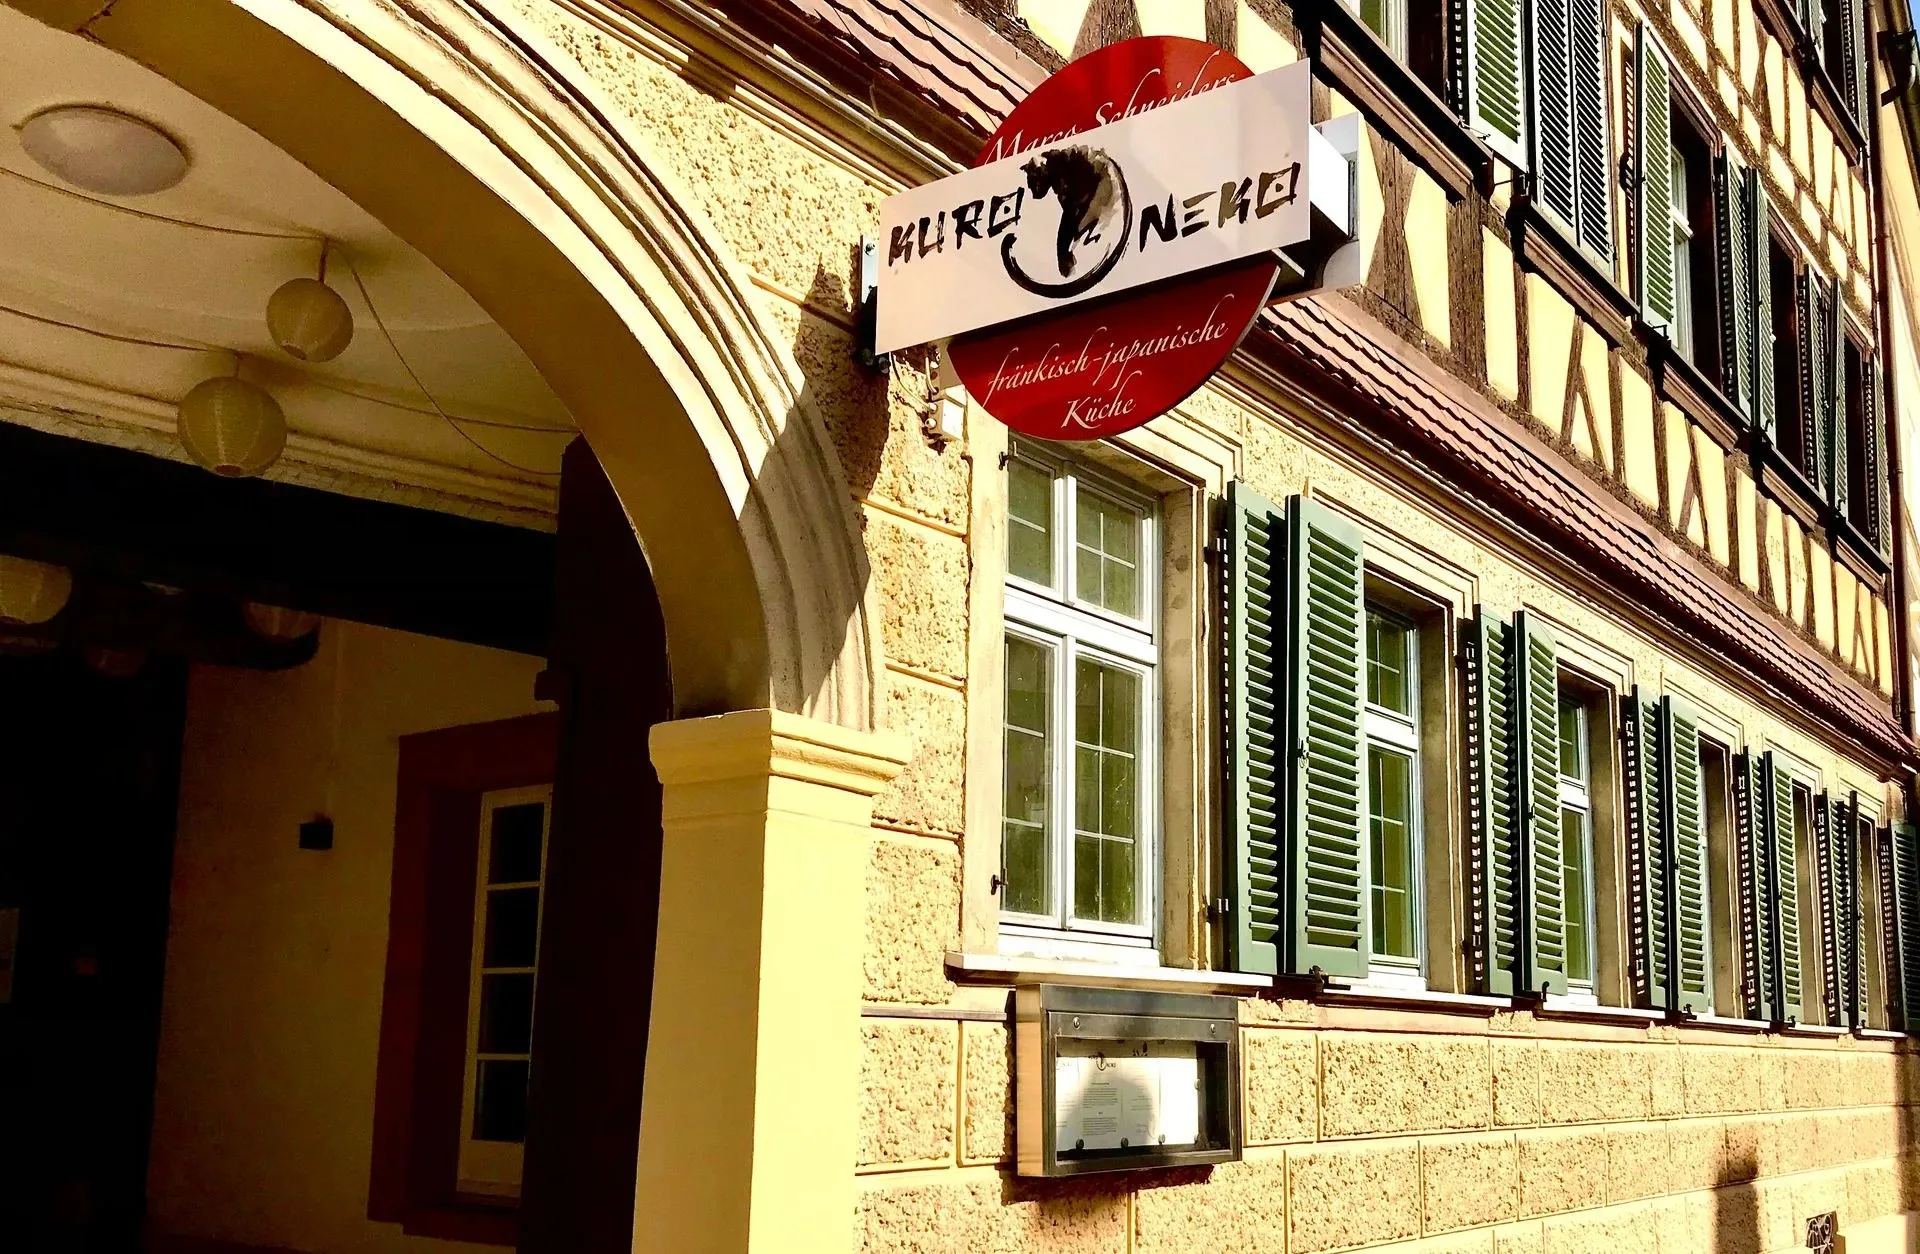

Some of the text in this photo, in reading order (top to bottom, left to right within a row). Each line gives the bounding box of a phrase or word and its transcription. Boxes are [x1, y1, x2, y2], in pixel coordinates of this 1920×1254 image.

[984, 49, 1236, 165] Marco Schneiders
[888, 161, 1301, 267] KURO NEKO
[982, 293, 1235, 408] fränkisch-japanische
[1061, 370, 1143, 430] Küche
